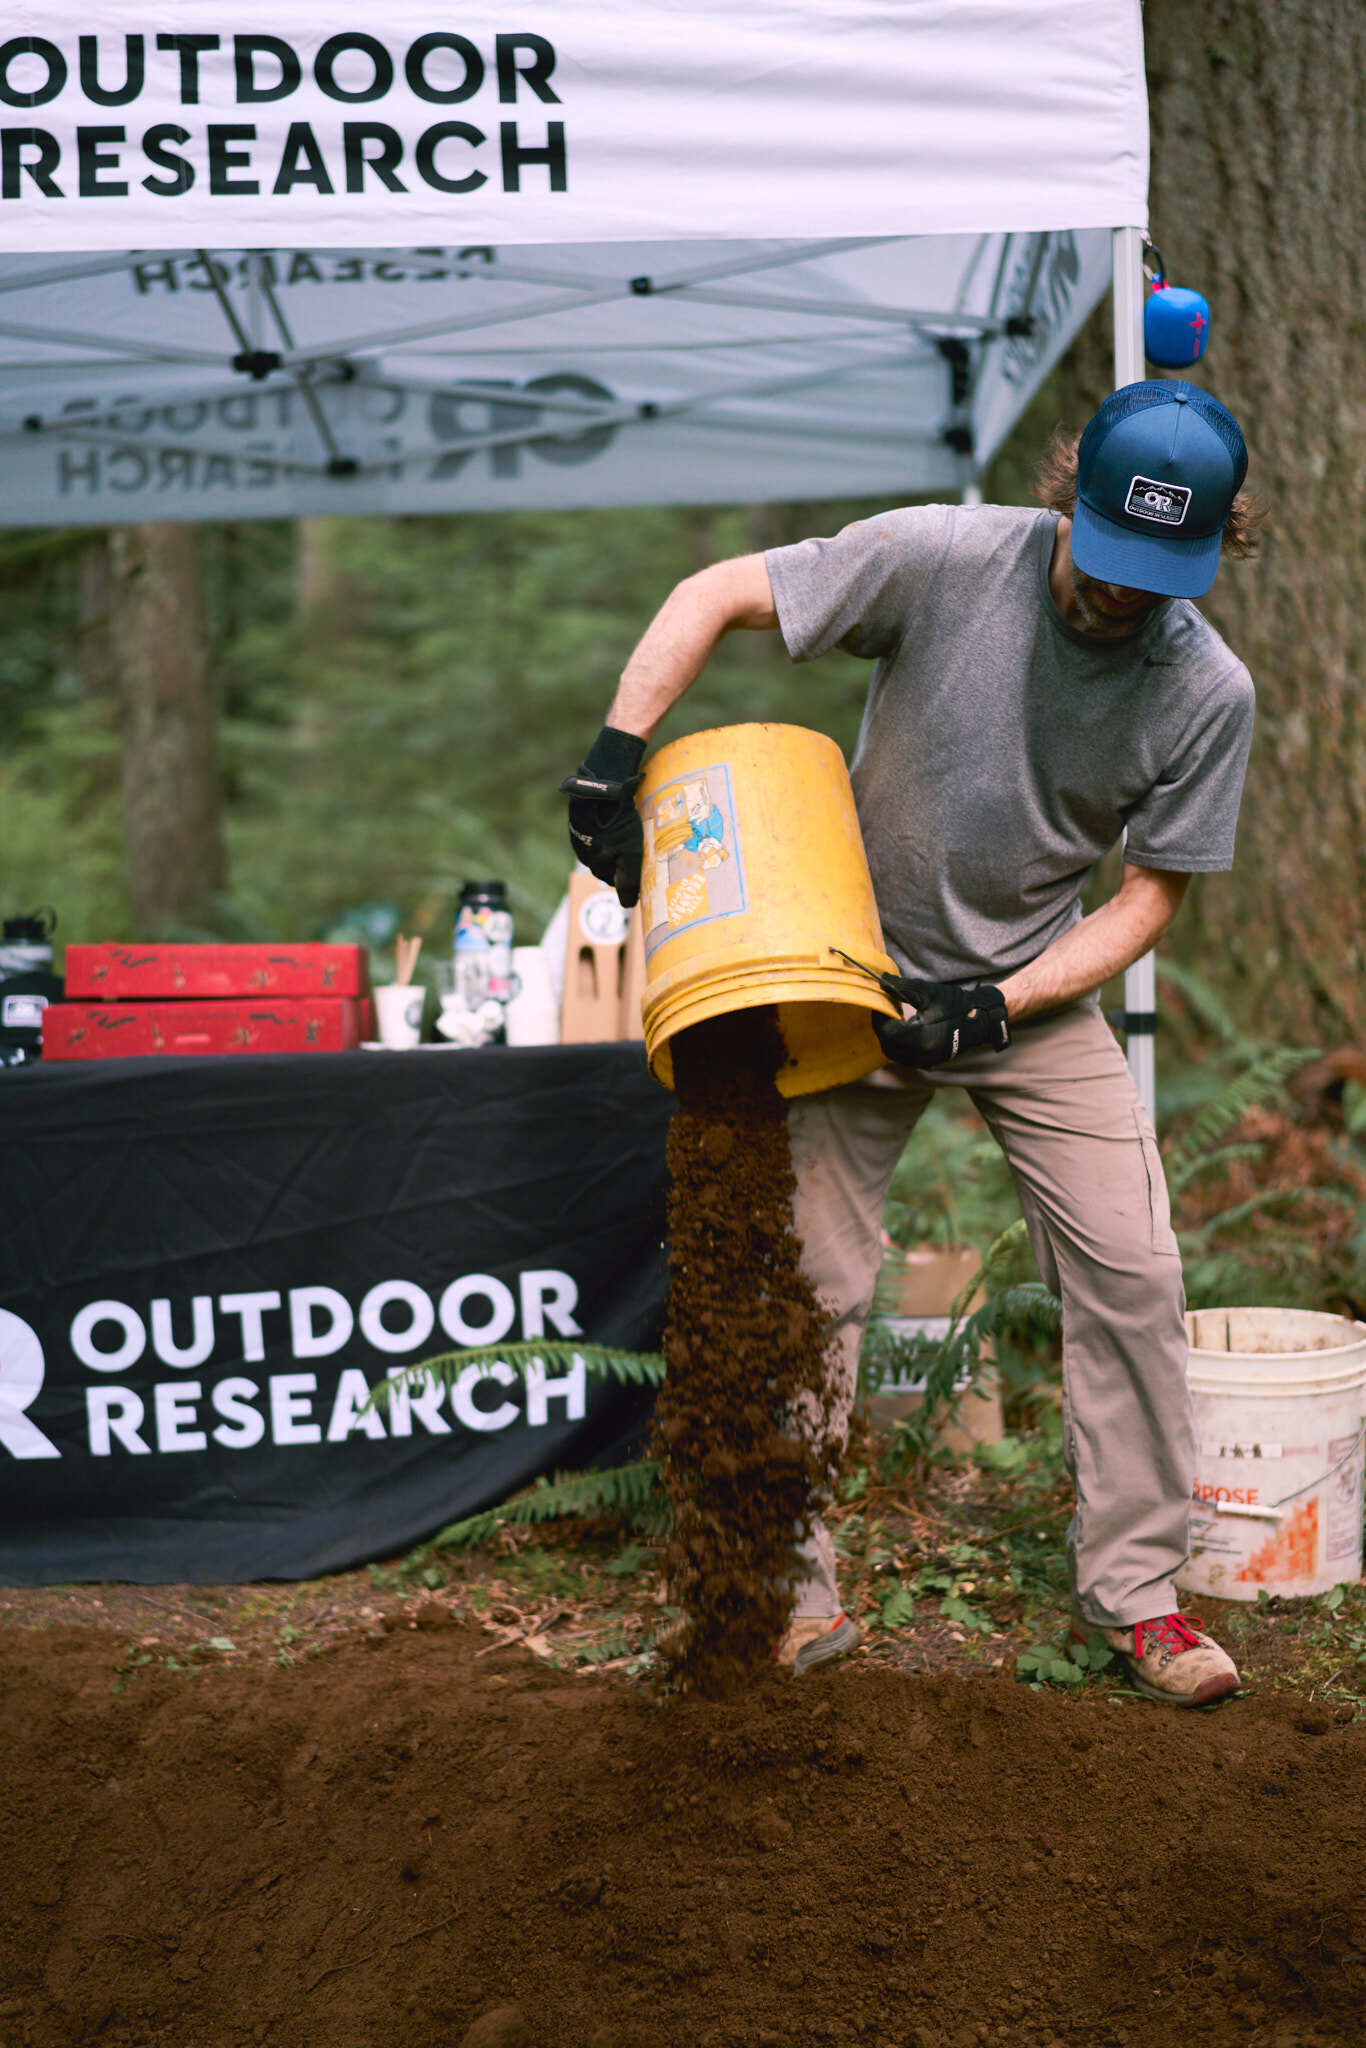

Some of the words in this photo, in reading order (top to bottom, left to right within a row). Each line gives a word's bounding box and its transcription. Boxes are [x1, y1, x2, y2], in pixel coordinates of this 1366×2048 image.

[0, 32, 562, 107] OUTDOOR
[0, 121, 568, 198] RESEARCH
[1144, 491, 1172, 512] OR
[70, 1269, 584, 1373] OUTDOOR
[85, 1352, 587, 1456] RESEARCH
